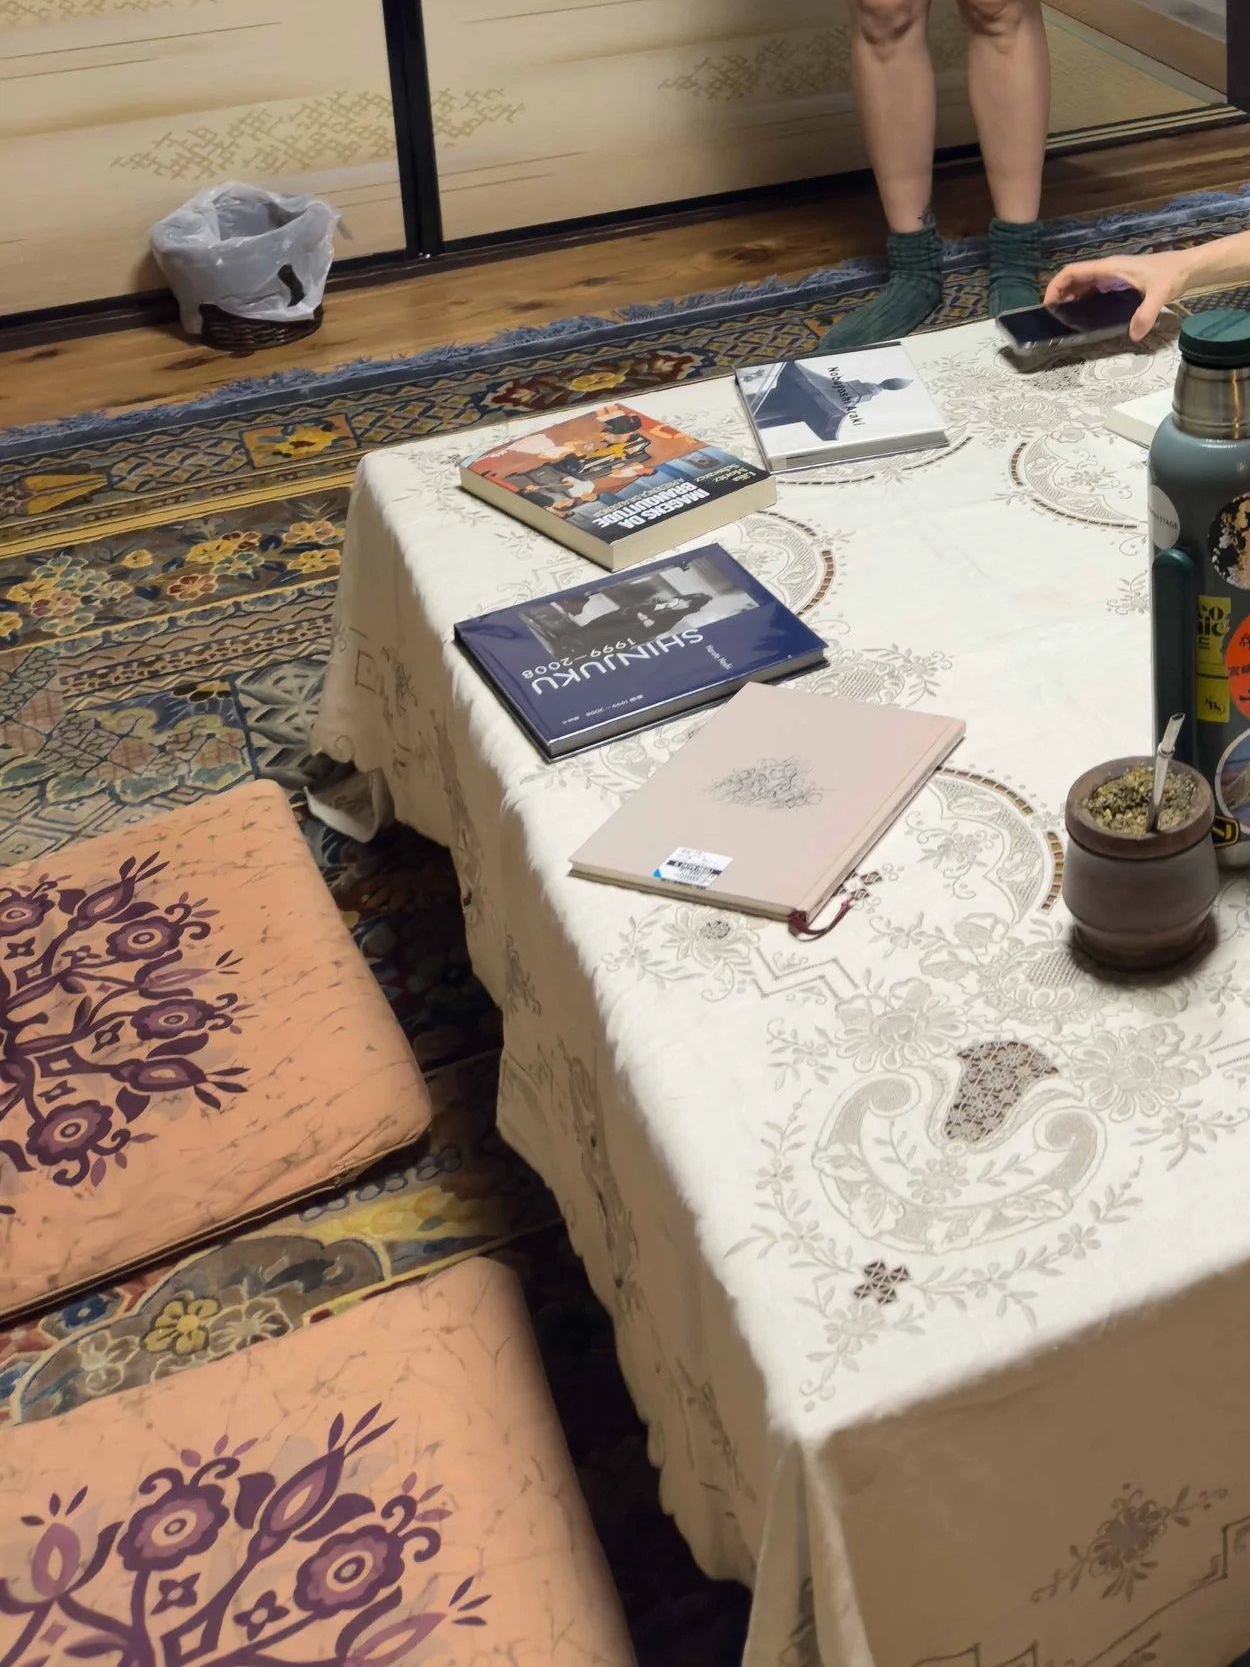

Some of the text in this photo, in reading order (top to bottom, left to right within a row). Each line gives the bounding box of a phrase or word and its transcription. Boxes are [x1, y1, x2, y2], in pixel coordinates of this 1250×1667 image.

[846, 406, 866, 427] Araki
[592, 481, 698, 528] BRANQUITUDE
[618, 489, 710, 528] IMAGENS DA
[531, 628, 704, 695] SHINJUKU
